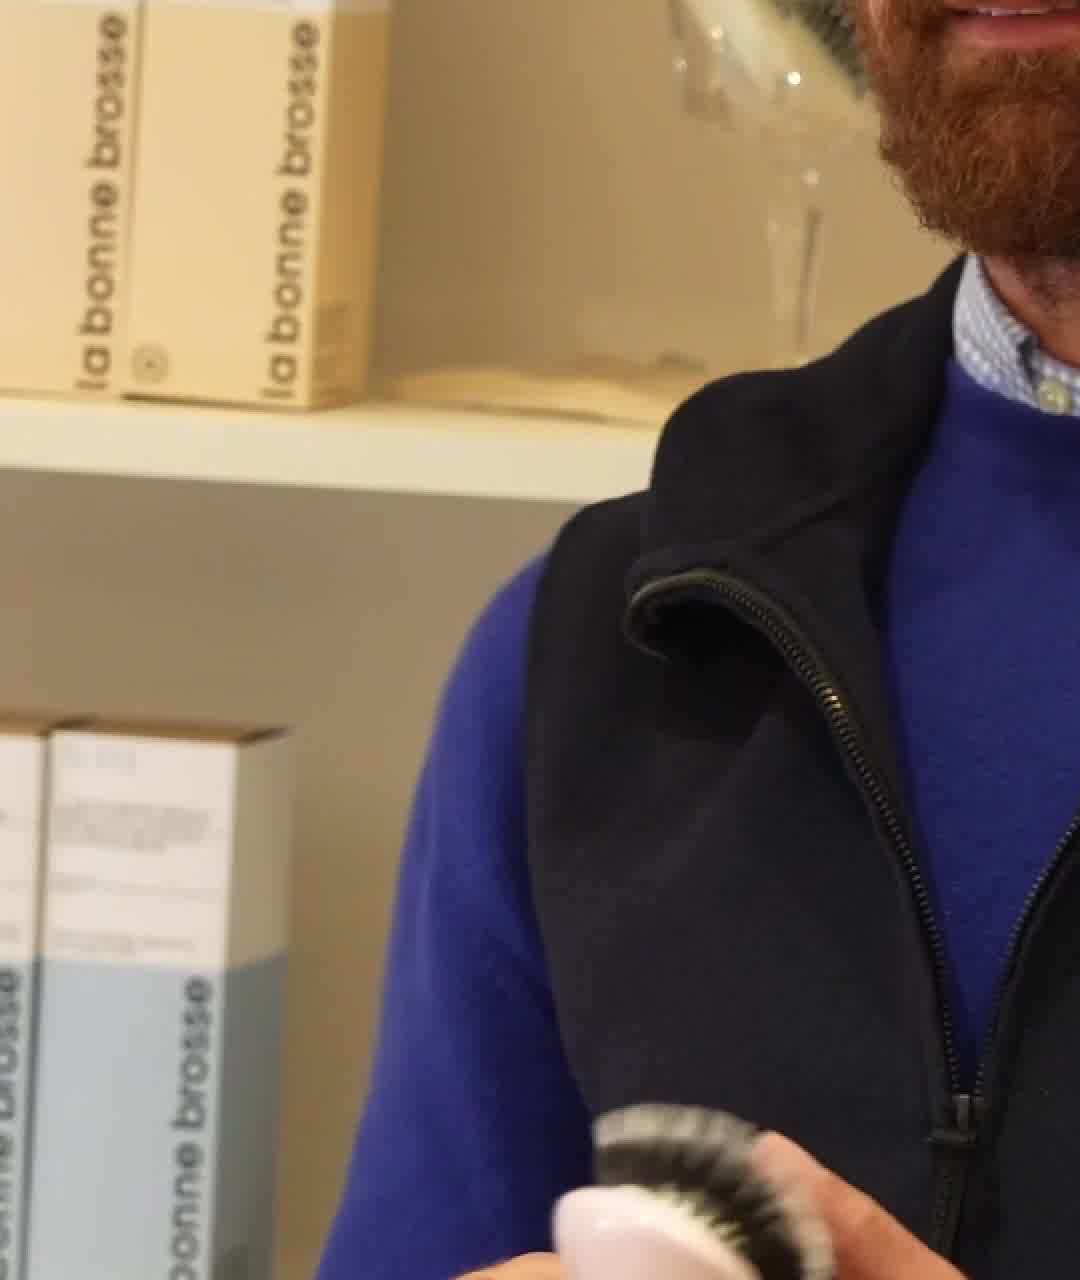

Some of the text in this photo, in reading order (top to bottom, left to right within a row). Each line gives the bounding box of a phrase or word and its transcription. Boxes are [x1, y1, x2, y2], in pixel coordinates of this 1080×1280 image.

[75, 11, 129, 391] la bonne brosse
[261, 19, 320, 400] la bonne brosse
[172, 976, 213, 1132] brosse
